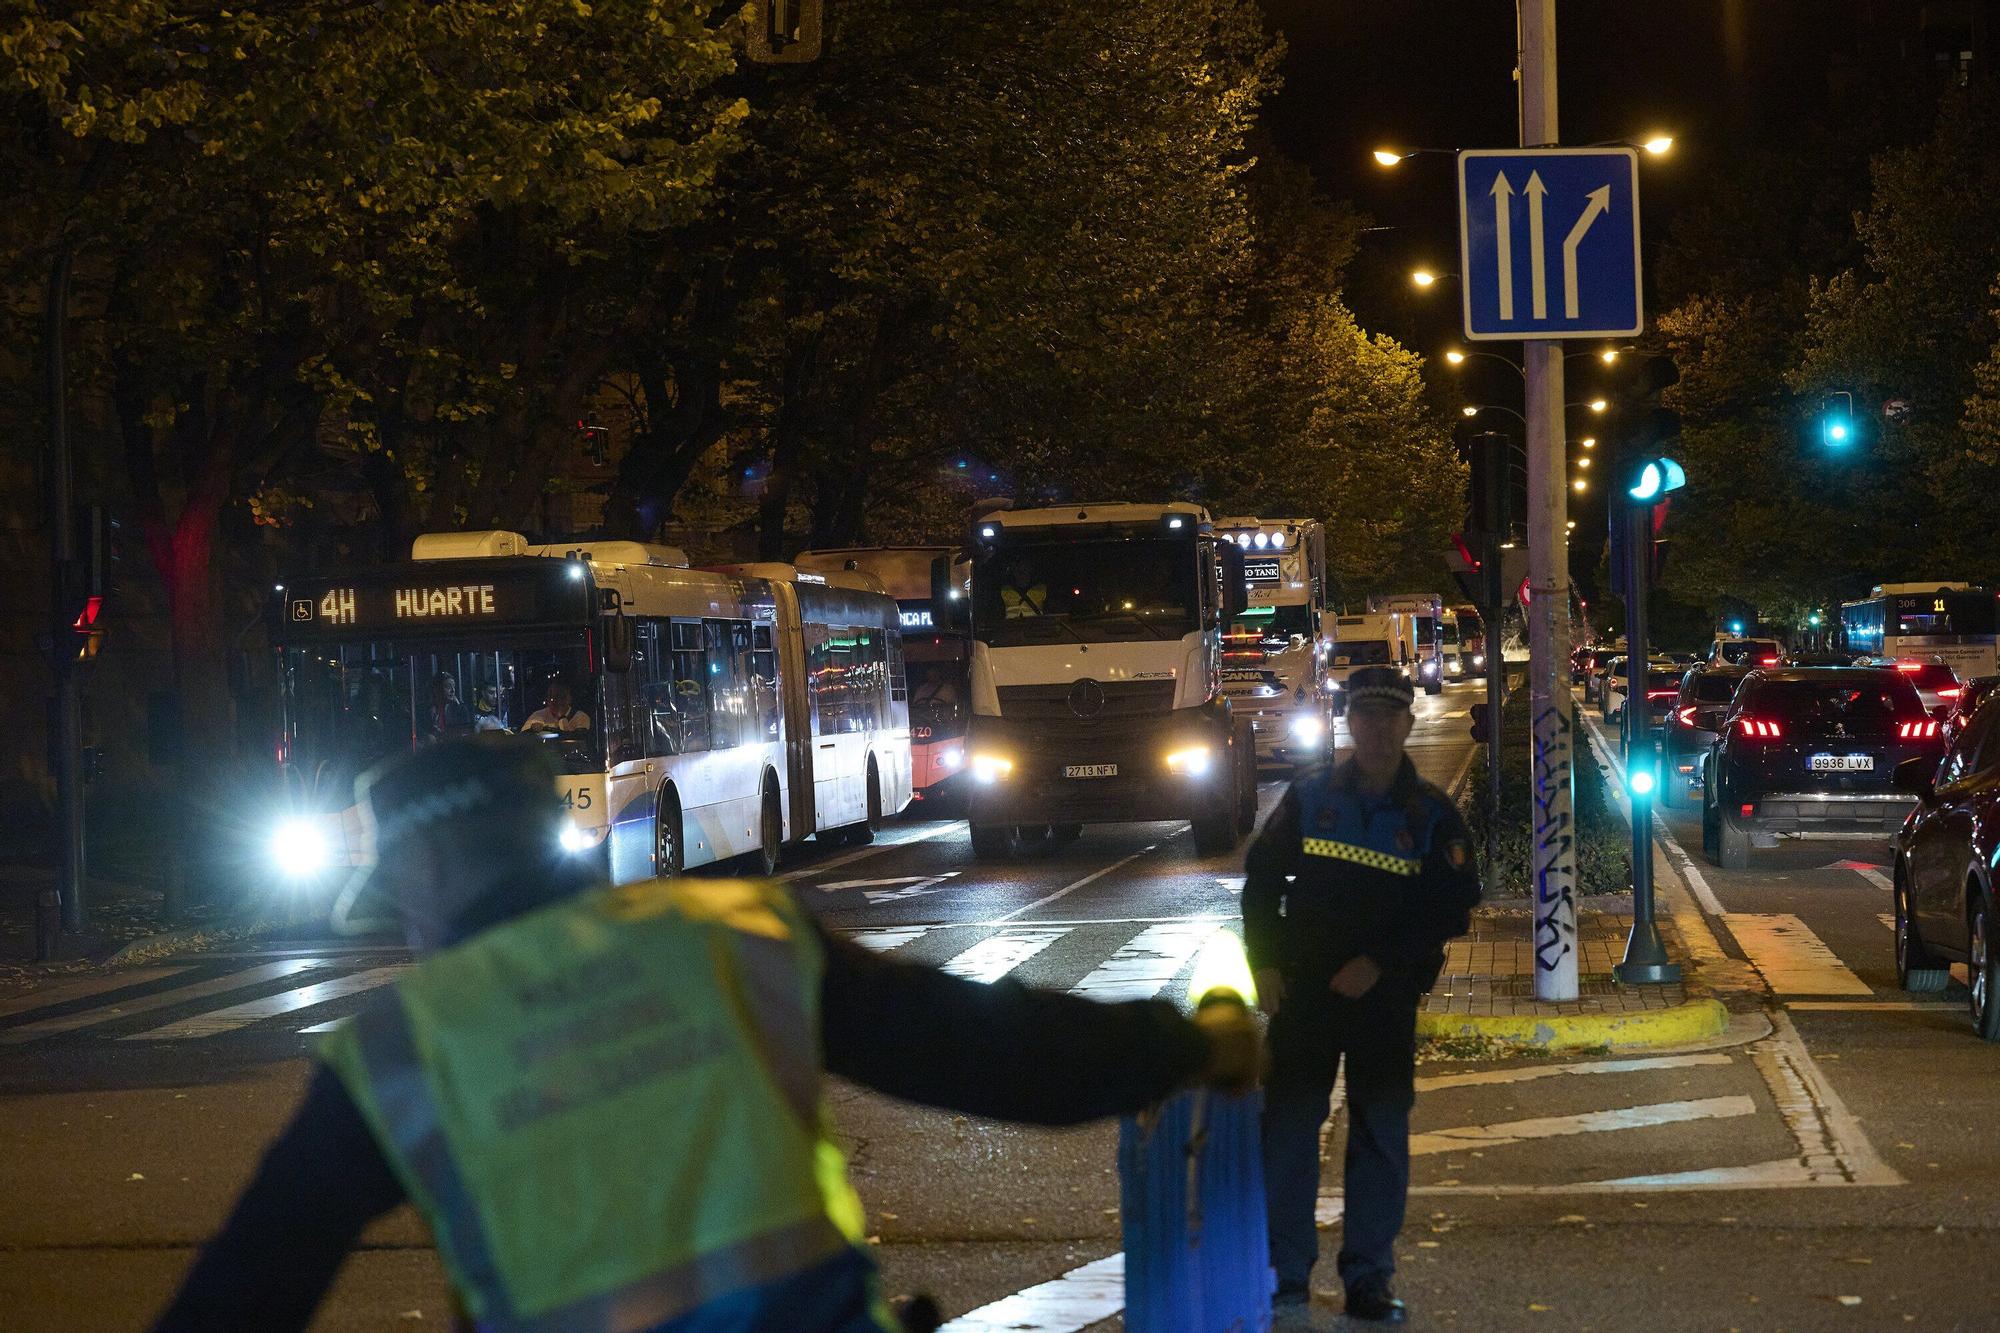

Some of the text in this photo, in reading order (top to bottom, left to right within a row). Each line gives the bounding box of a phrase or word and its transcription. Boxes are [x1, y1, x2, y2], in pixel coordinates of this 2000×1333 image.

[1255, 568, 1277, 577] TANK
[320, 585, 495, 624] 4H HUARTE
[1898, 599, 1916, 608] 306
[1934, 599, 1946, 611] 11
[899, 612, 920, 625] NCA
[1221, 672, 1263, 680] CANIA
[1814, 758, 1870, 768] 9936 LVX
[1068, 765, 1116, 776] 2713 NFY
